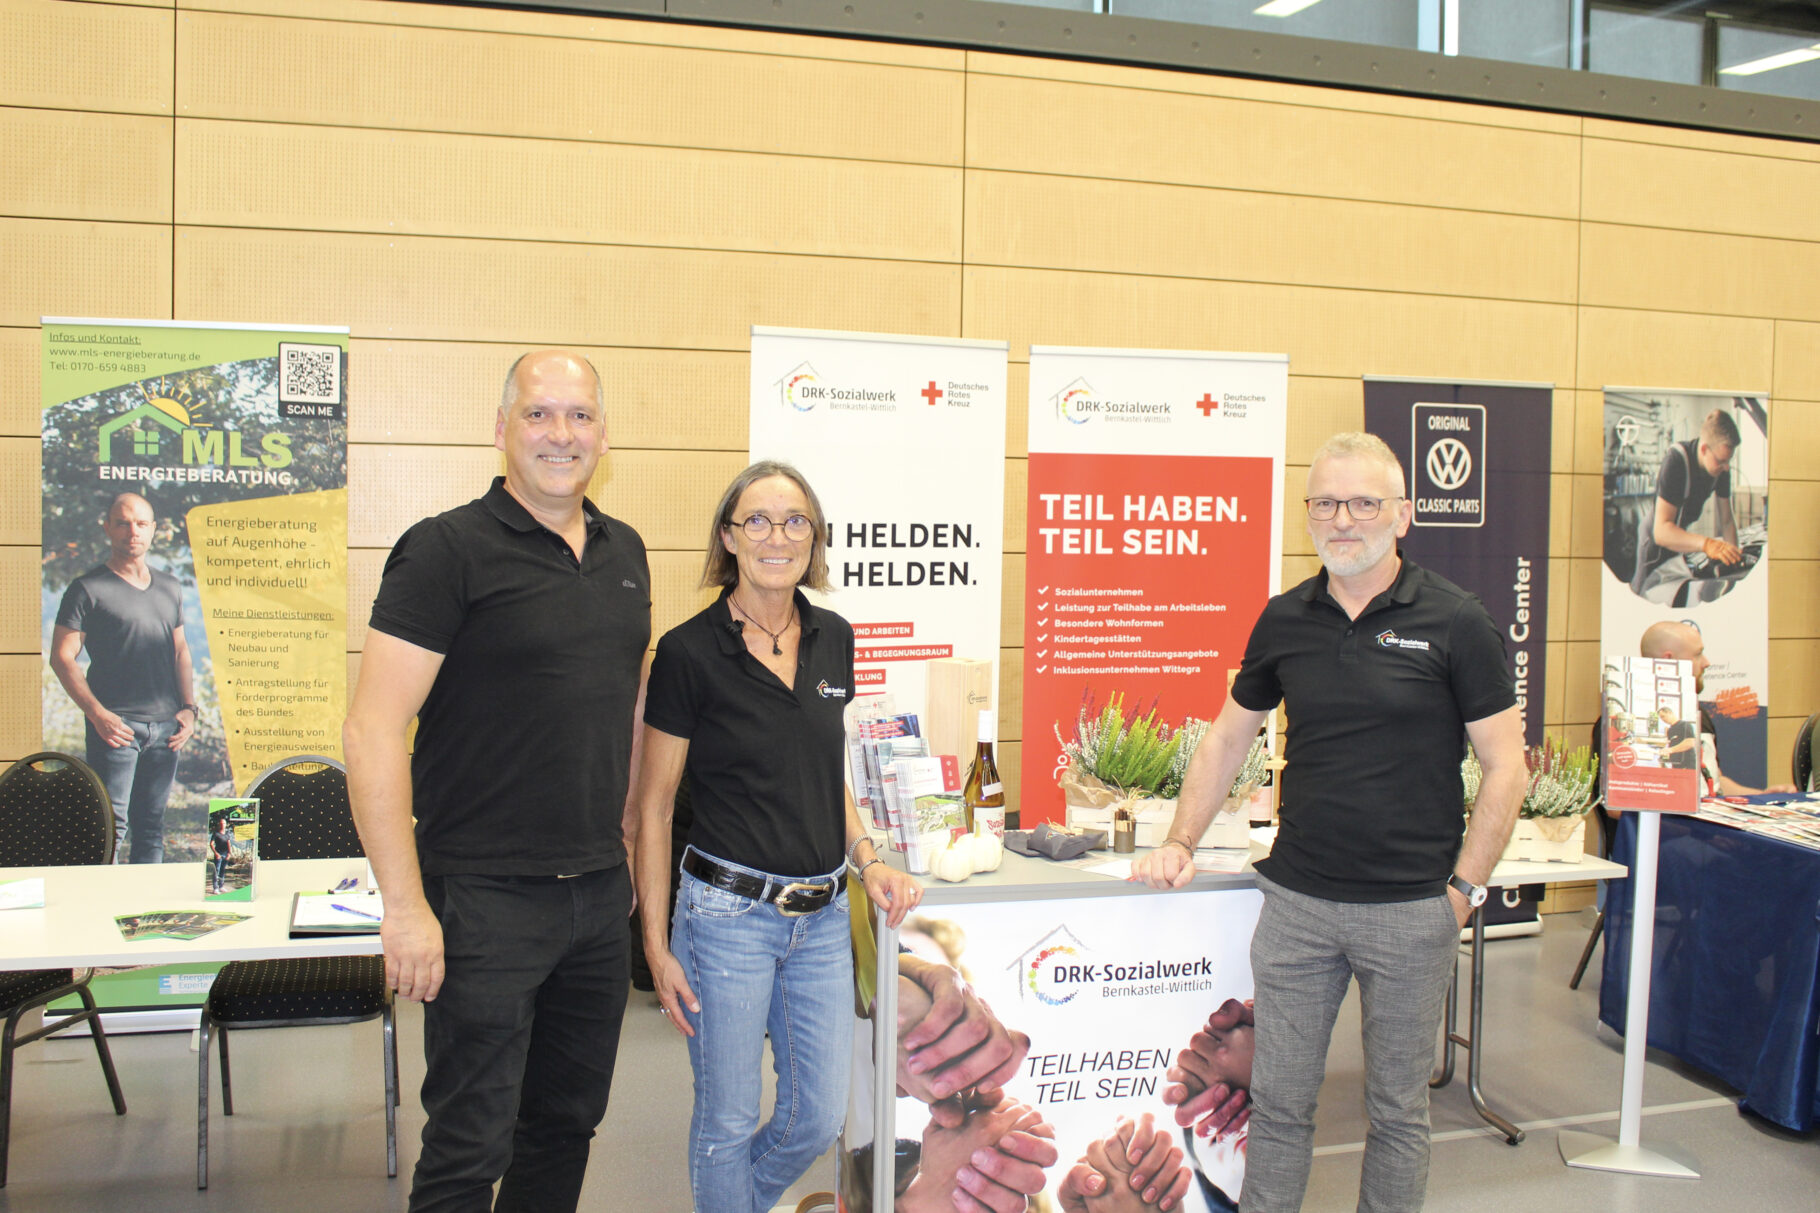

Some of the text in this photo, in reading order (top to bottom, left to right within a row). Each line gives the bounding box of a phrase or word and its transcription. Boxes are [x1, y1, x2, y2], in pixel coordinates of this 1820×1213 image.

[49, 332, 141, 345] Infos und Kontakt:
[50, 348, 200, 362] www.mls-energieberatung.de
[50, 361, 146, 373] Tel: 0170-659 4883
[948, 381, 989, 392] Deutsches
[802, 386, 896, 402] DRK-Sozialwerk
[948, 390, 971, 399] Rotes
[1224, 393, 1266, 402] Deutsches
[830, 402, 897, 412] Bernkastel-Wittlich
[948, 399, 970, 408] Kreuz
[1076, 400, 1171, 414] DRK-Sozialwerk
[1224, 402, 1247, 410] Rotes
[286, 404, 334, 417] SCAN ME
[1223, 410, 1247, 418] Kreuz
[1428, 415, 1470, 431] ORIGINAL
[182, 429, 293, 468] MLS
[100, 466, 292, 486] ENERGIEBERATUNG
[1040, 494, 1248, 522] TEIL HABEN.
[1416, 498, 1480, 514] CLASSIC PARTS
[206, 516, 317, 534] Energieberatung
[846, 523, 981, 548] HELDEN.
[206, 536, 228, 547] auf
[232, 536, 307, 551] Augenhöhe
[1038, 528, 1208, 556] TEIL SEIN.
[206, 556, 331, 570] kompetent, ehrlich
[843, 562, 978, 587] HELDEN.
[206, 576, 308, 588] und individuell!
[1054, 588, 1144, 597] Sozialunternehmen
[1510, 556, 1532, 643] Center
[212, 608, 334, 621] Meine Dienstleistungen:
[1054, 603, 1226, 614] Leistung zur Teilhabe am Arbeitsleben
[1054, 618, 1164, 628] Besondere Wohnformen
[228, 628, 329, 640] Energieberatung für
[872, 626, 910, 635] ARBEITEN
[1054, 634, 1142, 645] Kindertagesstätten
[228, 644, 288, 653] Neubau und
[872, 648, 949, 658] BEGEGNUNGSRAUM
[1054, 649, 1219, 660] Allgemeine Unterstützungsangebote
[228, 658, 280, 669] Sanierung
[854, 672, 883, 681] KLUNG
[1054, 665, 1200, 676] Inklusionsunternehmen Wittegra
[236, 678, 329, 689] Antragstellung für
[236, 692, 328, 704] Förderprogramme
[236, 708, 294, 717] des Bundes
[244, 728, 325, 738] Ausstellung von
[244, 742, 336, 752] Energieausweisen
[1054, 957, 1212, 984] DRK-Sozialwerk
[1102, 979, 1212, 998] Bernkastel-Wittlich
[1028, 1048, 1172, 1078] TEILHABEN
[1036, 1076, 1158, 1104] TEIL SEIN
